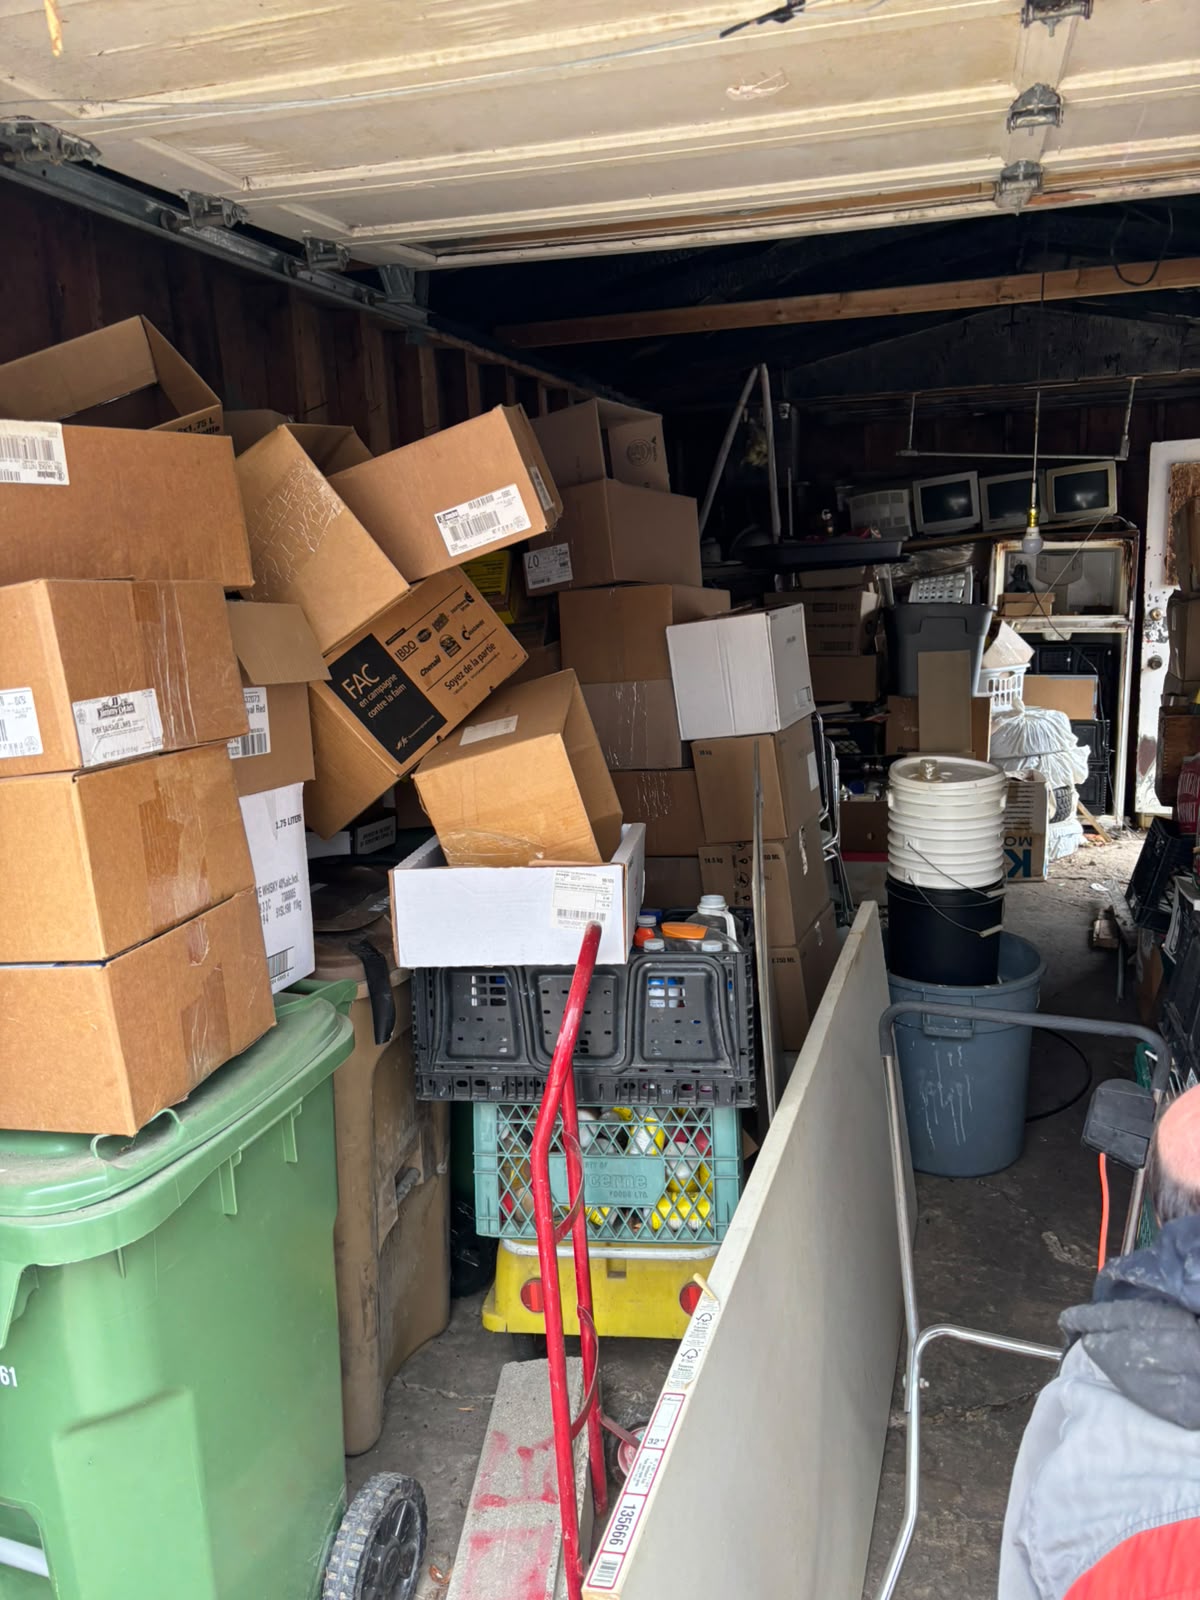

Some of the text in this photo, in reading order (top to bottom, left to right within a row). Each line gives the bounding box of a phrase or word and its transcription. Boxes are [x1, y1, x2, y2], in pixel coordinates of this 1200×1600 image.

[397, 640, 417, 661] BDO
[444, 671, 465, 691] Soyez
[463, 664, 473, 675] de
[472, 657, 480, 667] la
[478, 642, 496, 662] partie
[341, 663, 380, 700] FAC
[358, 673, 398, 709] en campagne
[255, 704, 266, 713] Red
[367, 699, 389, 719] contre
[392, 683, 407, 698] faim
[275, 813, 302, 830] 1.75 LITERS
[584, 1173, 648, 1189] cerne
[609, 1503, 636, 1546] 135666
